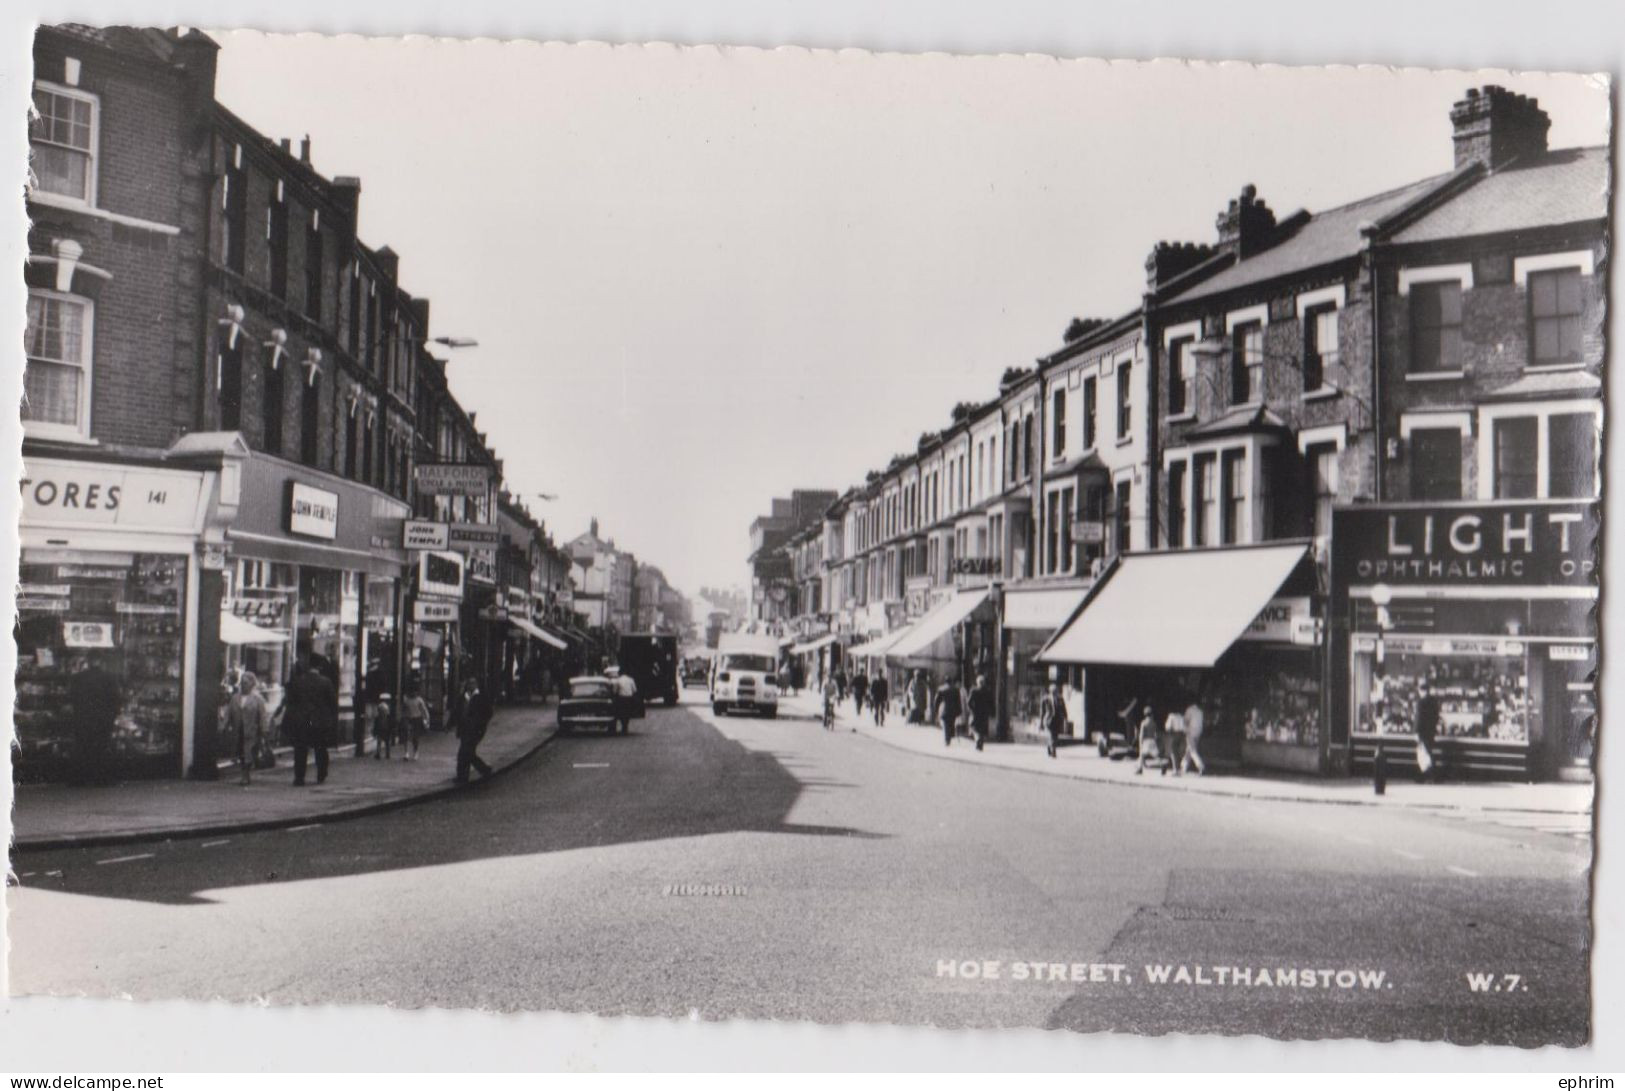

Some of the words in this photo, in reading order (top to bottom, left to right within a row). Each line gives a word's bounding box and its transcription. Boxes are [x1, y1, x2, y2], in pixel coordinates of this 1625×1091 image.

[419, 467, 485, 479] HALFORDS
[147, 490, 167, 505] 141
[292, 499, 312, 517] JOHN
[313, 503, 336, 522] TEMPLE
[408, 526, 435, 534] JOHN
[1387, 512, 1583, 555] LIGHT
[408, 536, 444, 545] TEMPLE
[1356, 559, 1524, 577] OPHTHALMIC
